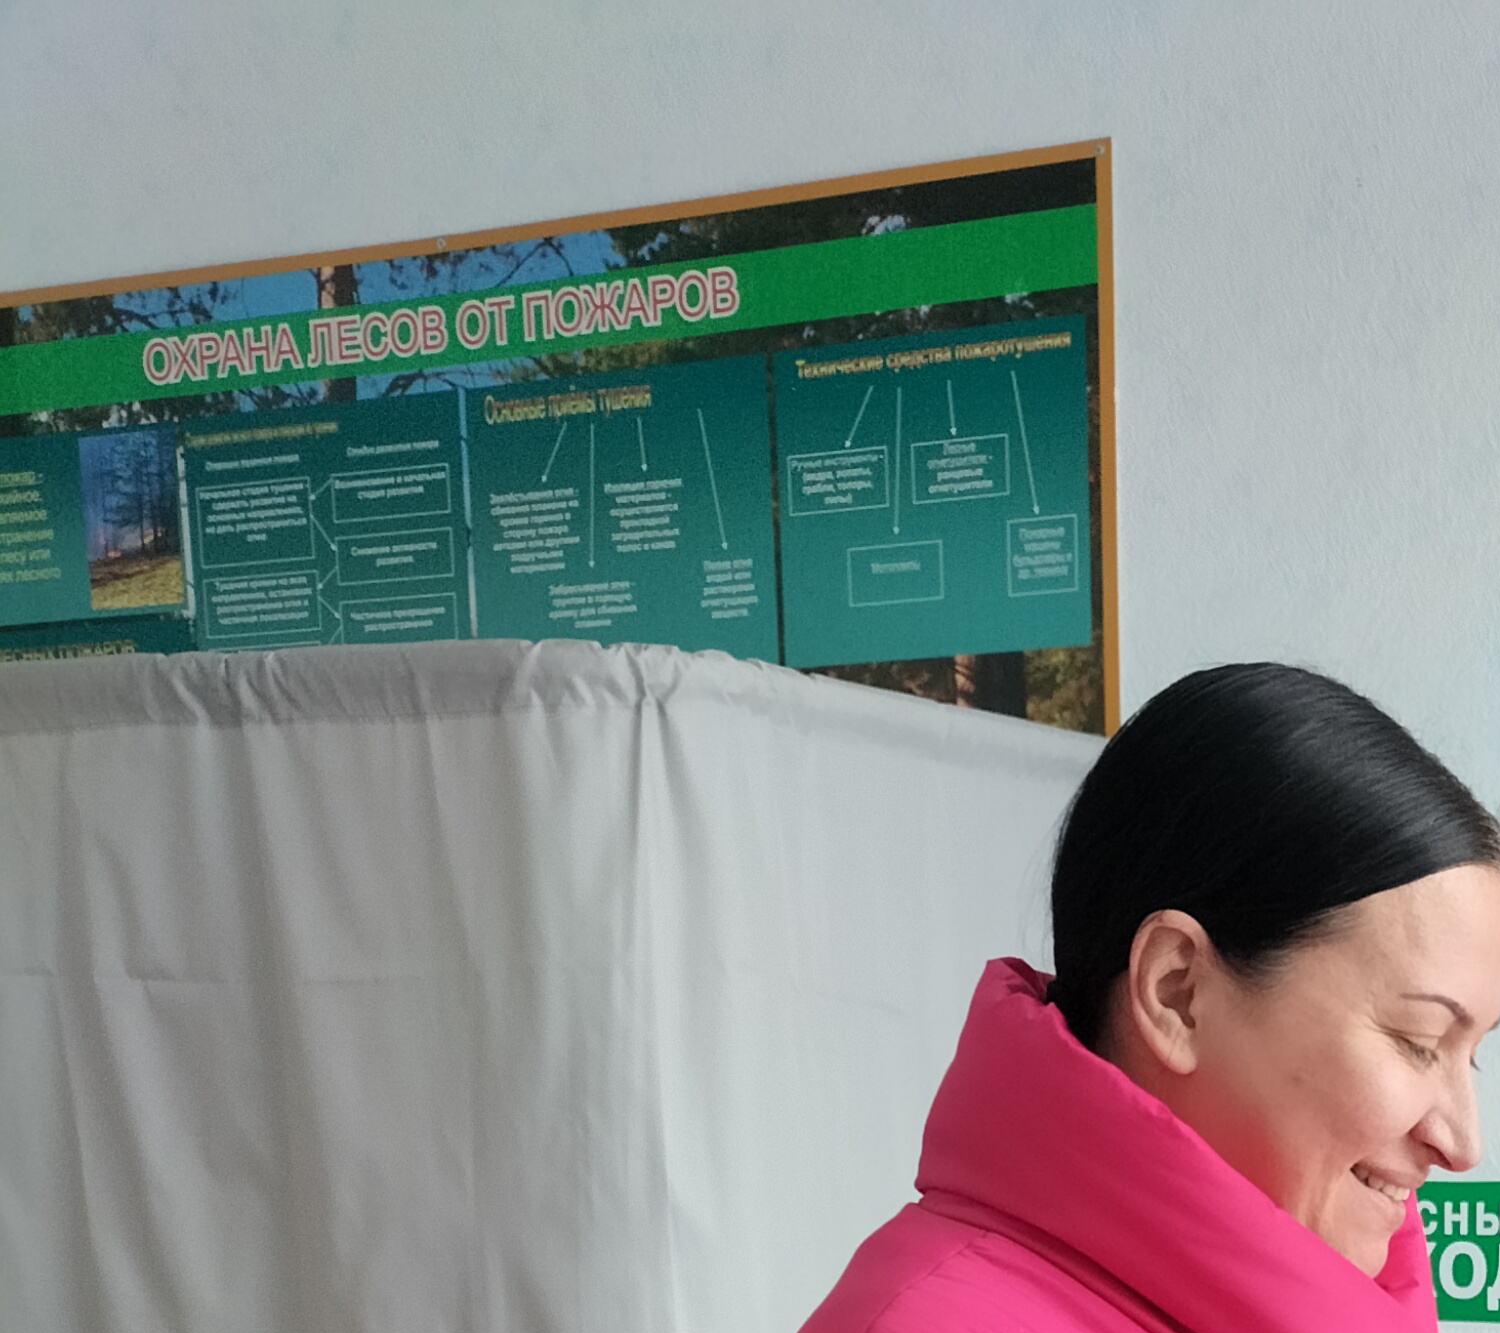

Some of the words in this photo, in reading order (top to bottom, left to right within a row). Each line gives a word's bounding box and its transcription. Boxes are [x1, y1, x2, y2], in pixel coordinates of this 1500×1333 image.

[143, 322, 302, 385] ОХРАНА
[308, 305, 447, 368] ЛЕСОВ
[456, 296, 514, 350] ОТ
[521, 265, 740, 341] ПОЖАРОВ
